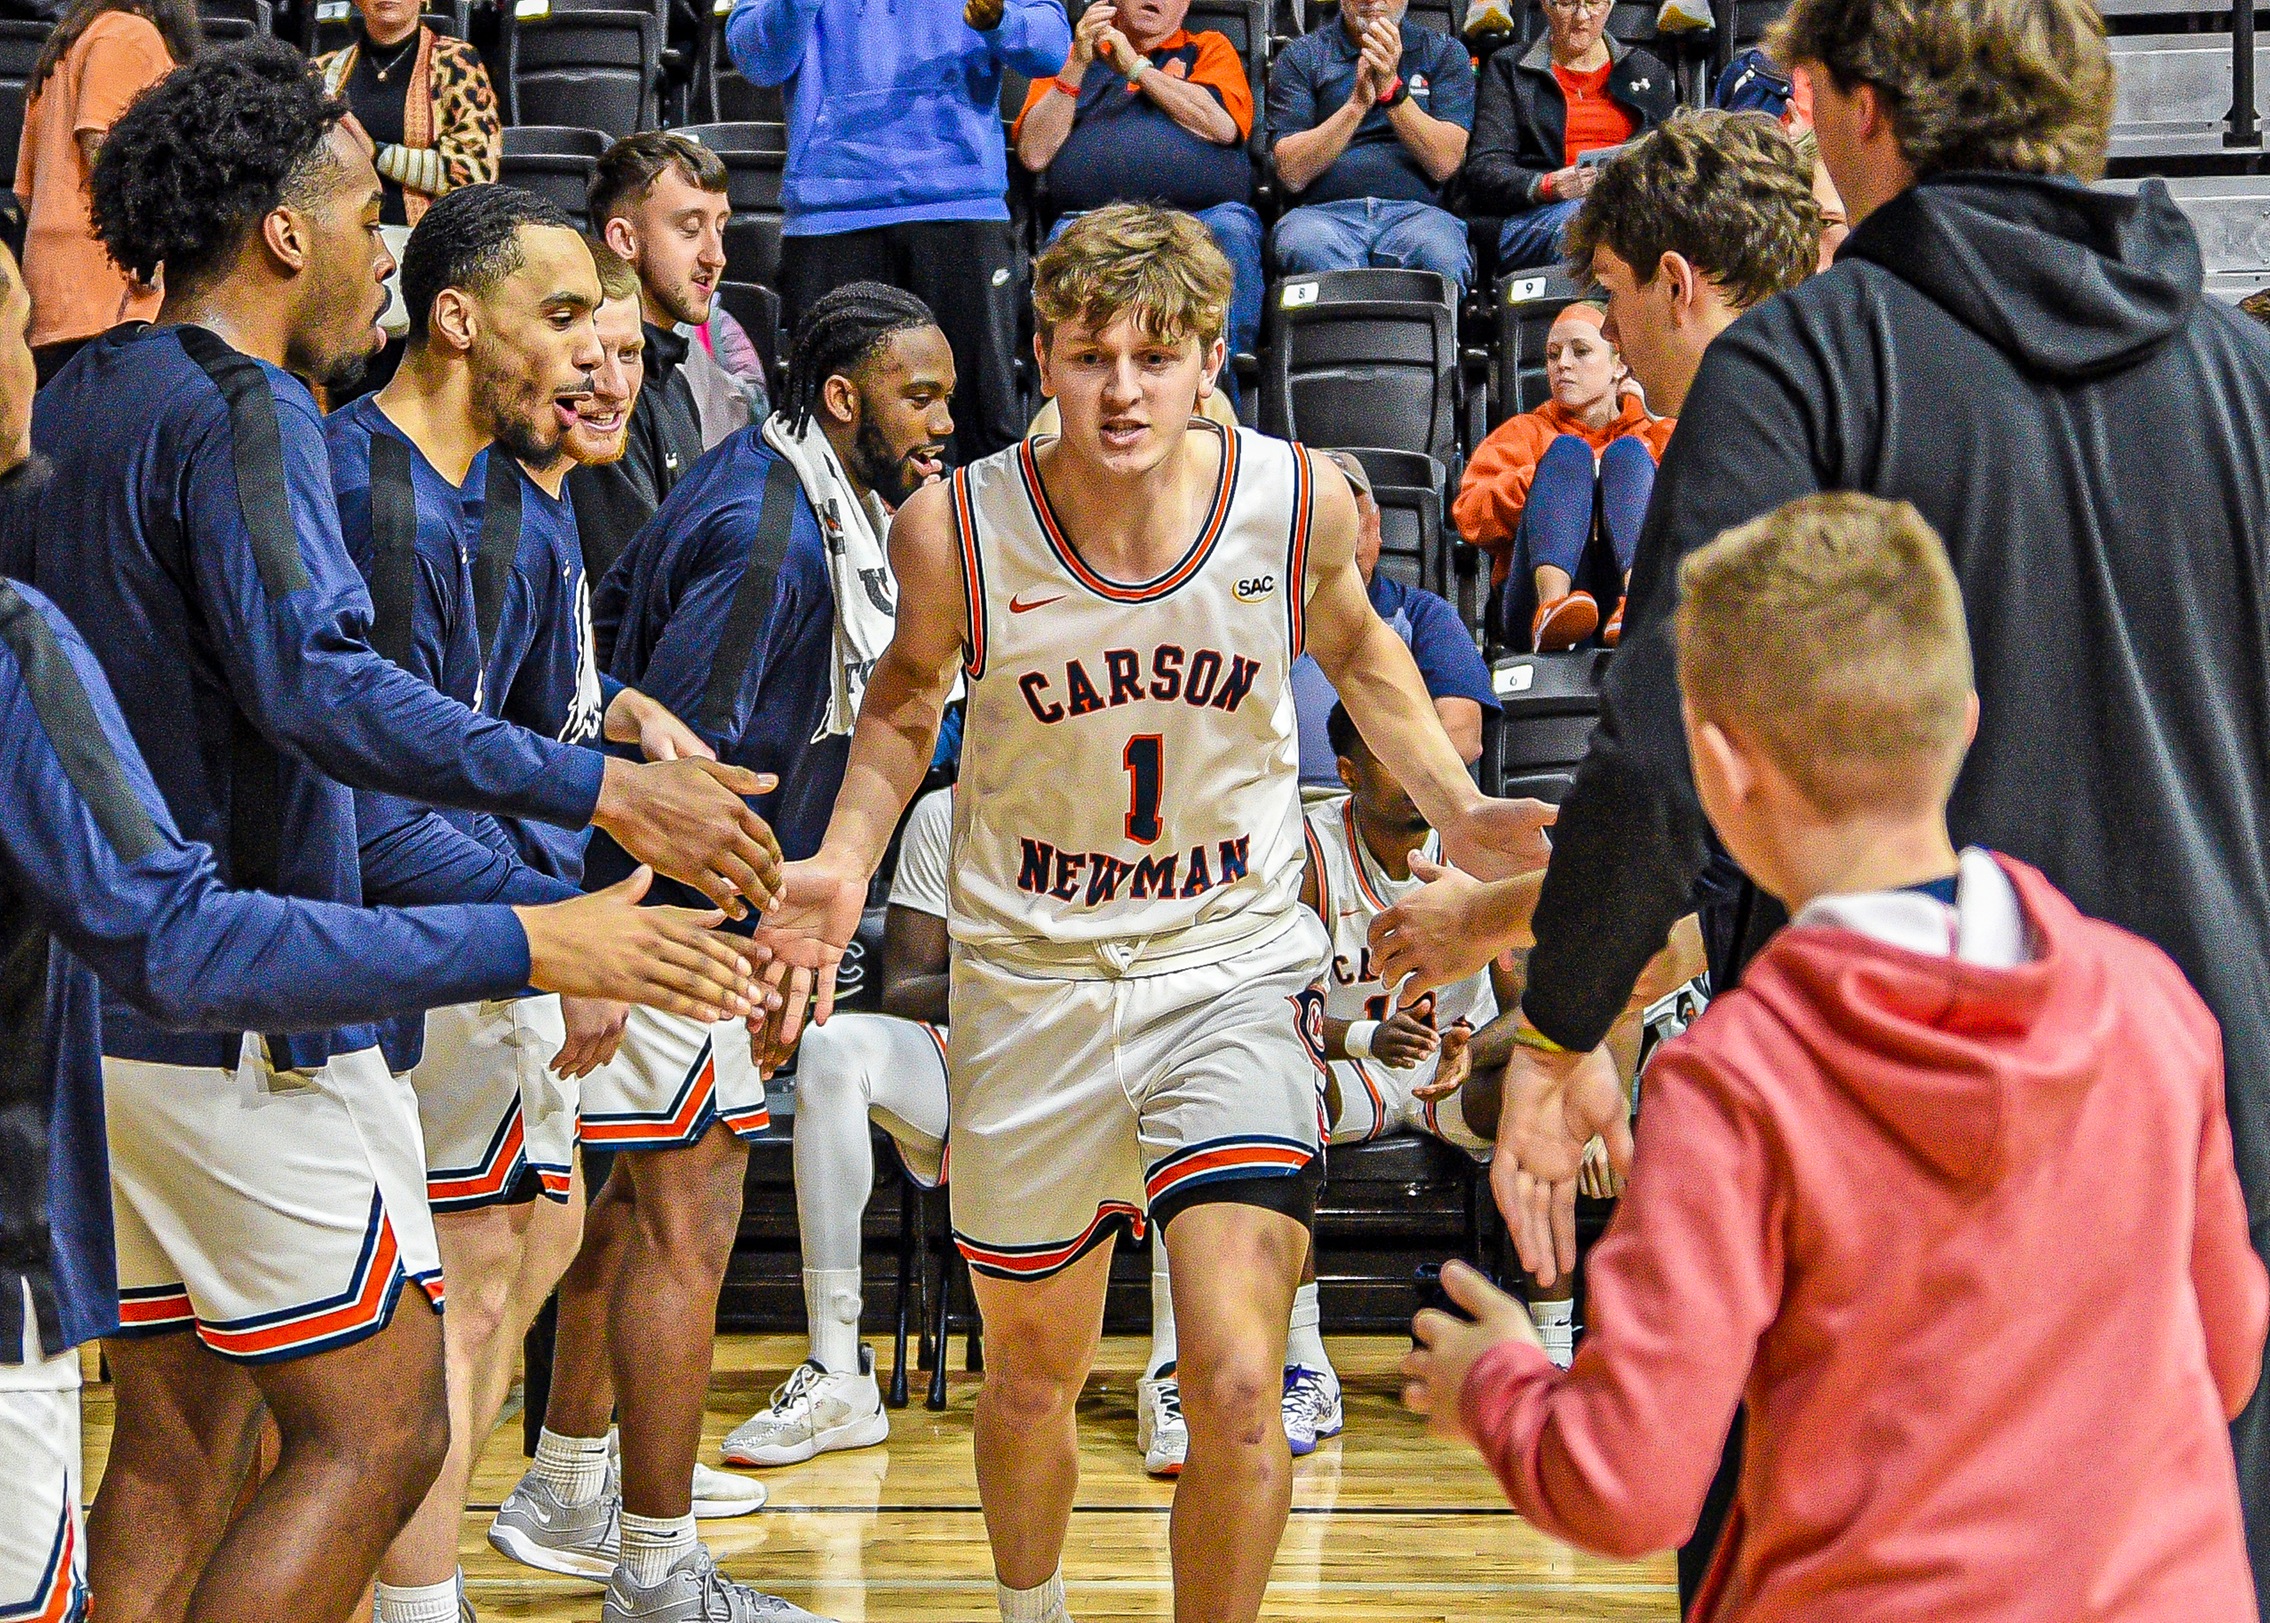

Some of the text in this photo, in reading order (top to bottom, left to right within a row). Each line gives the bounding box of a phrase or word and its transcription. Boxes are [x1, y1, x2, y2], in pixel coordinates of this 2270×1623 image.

[1298, 287, 1306, 299] 8
[1525, 282, 1534, 294] 9
[1238, 575, 1274, 597] SAC
[1018, 643, 1262, 724] CARSON
[1509, 675, 1518, 687] 6
[1122, 733, 1163, 845] 1
[1017, 832, 1251, 907] NEWMAN
